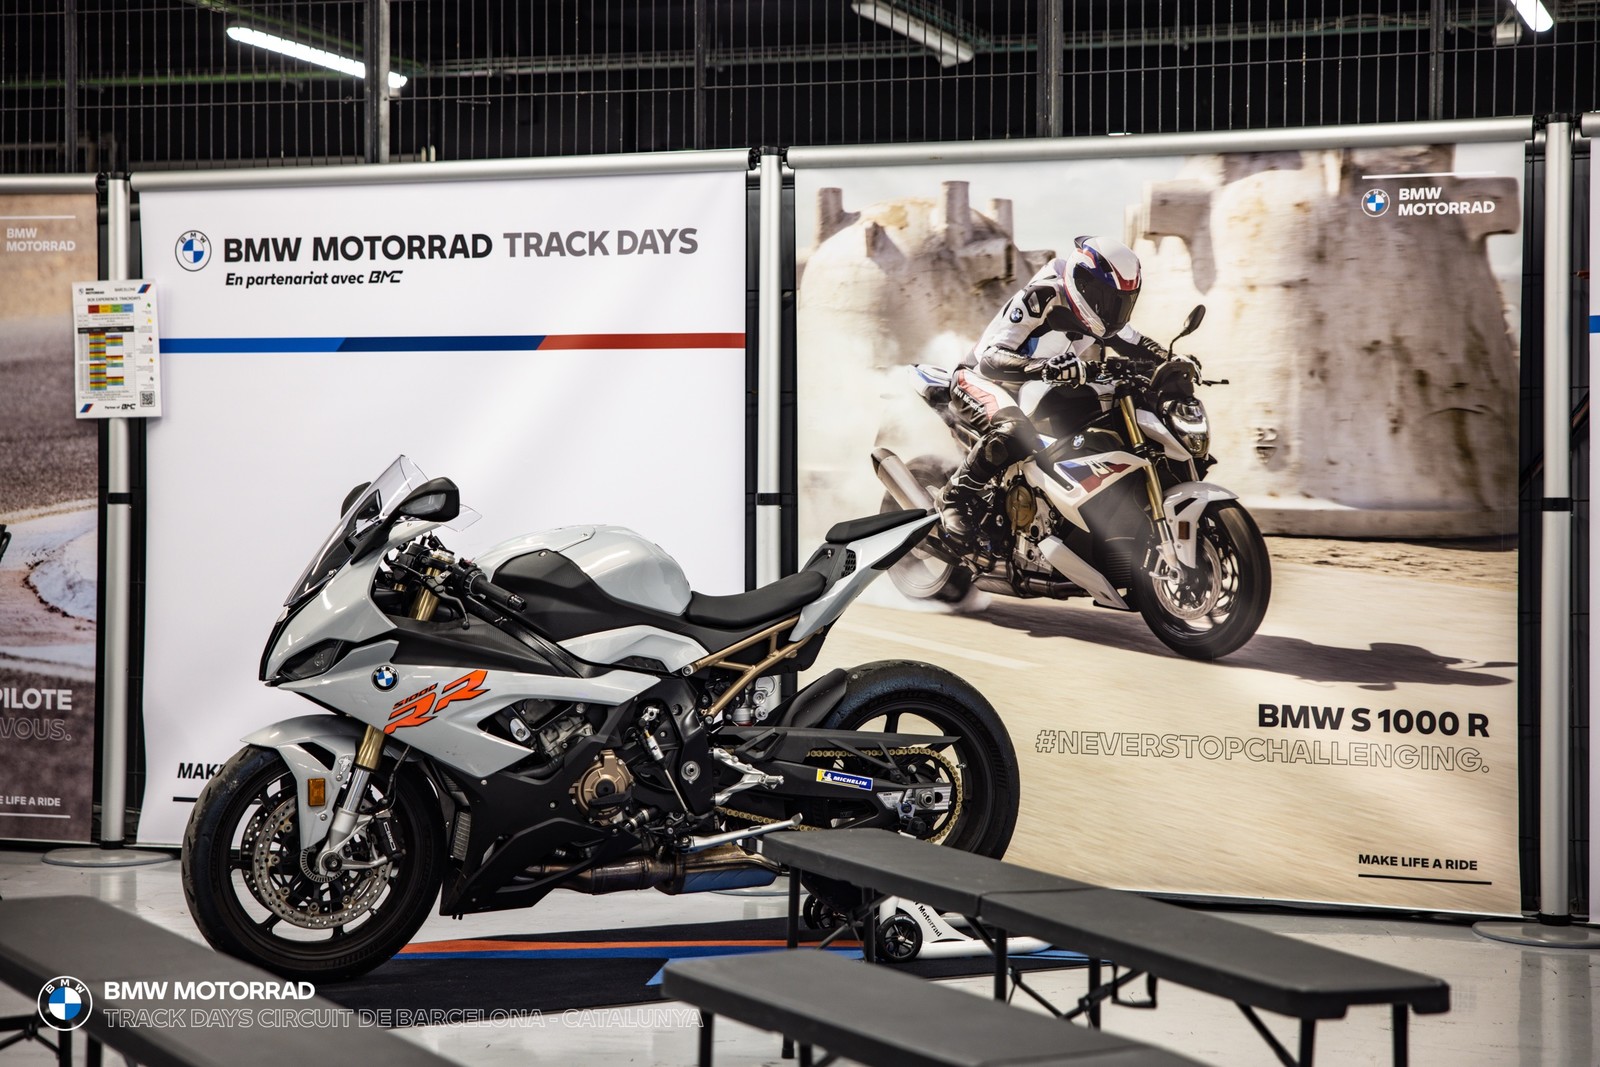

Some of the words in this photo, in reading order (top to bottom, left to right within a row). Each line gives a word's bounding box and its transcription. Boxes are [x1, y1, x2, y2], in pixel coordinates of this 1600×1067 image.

[1399, 187, 1442, 200] BMW
[1398, 201, 1496, 216] MOTORRAD
[7, 227, 38, 239] BMW
[6, 240, 76, 252] MOTORRAD
[224, 237, 302, 262] BMW
[312, 233, 493, 261] MOTORRAD
[503, 230, 610, 258] TRACK
[617, 228, 699, 255] DAYS
[225, 272, 243, 286] En
[246, 271, 329, 289] partenariat
[331, 274, 364, 285] avec
[0, 687, 73, 711] ILOTE
[1258, 703, 1345, 730] BMW
[1351, 707, 1371, 732] S
[1377, 708, 1460, 736] 1000
[1467, 712, 1490, 738] R
[1035, 729, 1490, 774] #NEVERSTOPCHALLENGING.
[833, 775, 868, 786] MICHELIN
[6, 796, 26, 805] LIFE
[28, 796, 36, 806] A
[38, 797, 61, 807] RIDE
[1358, 853, 1398, 866] MAKE
[1401, 856, 1429, 868] LIFE
[1432, 858, 1442, 869] A
[1445, 859, 1478, 871] RIDE
[918, 905, 943, 937] Motorrad
